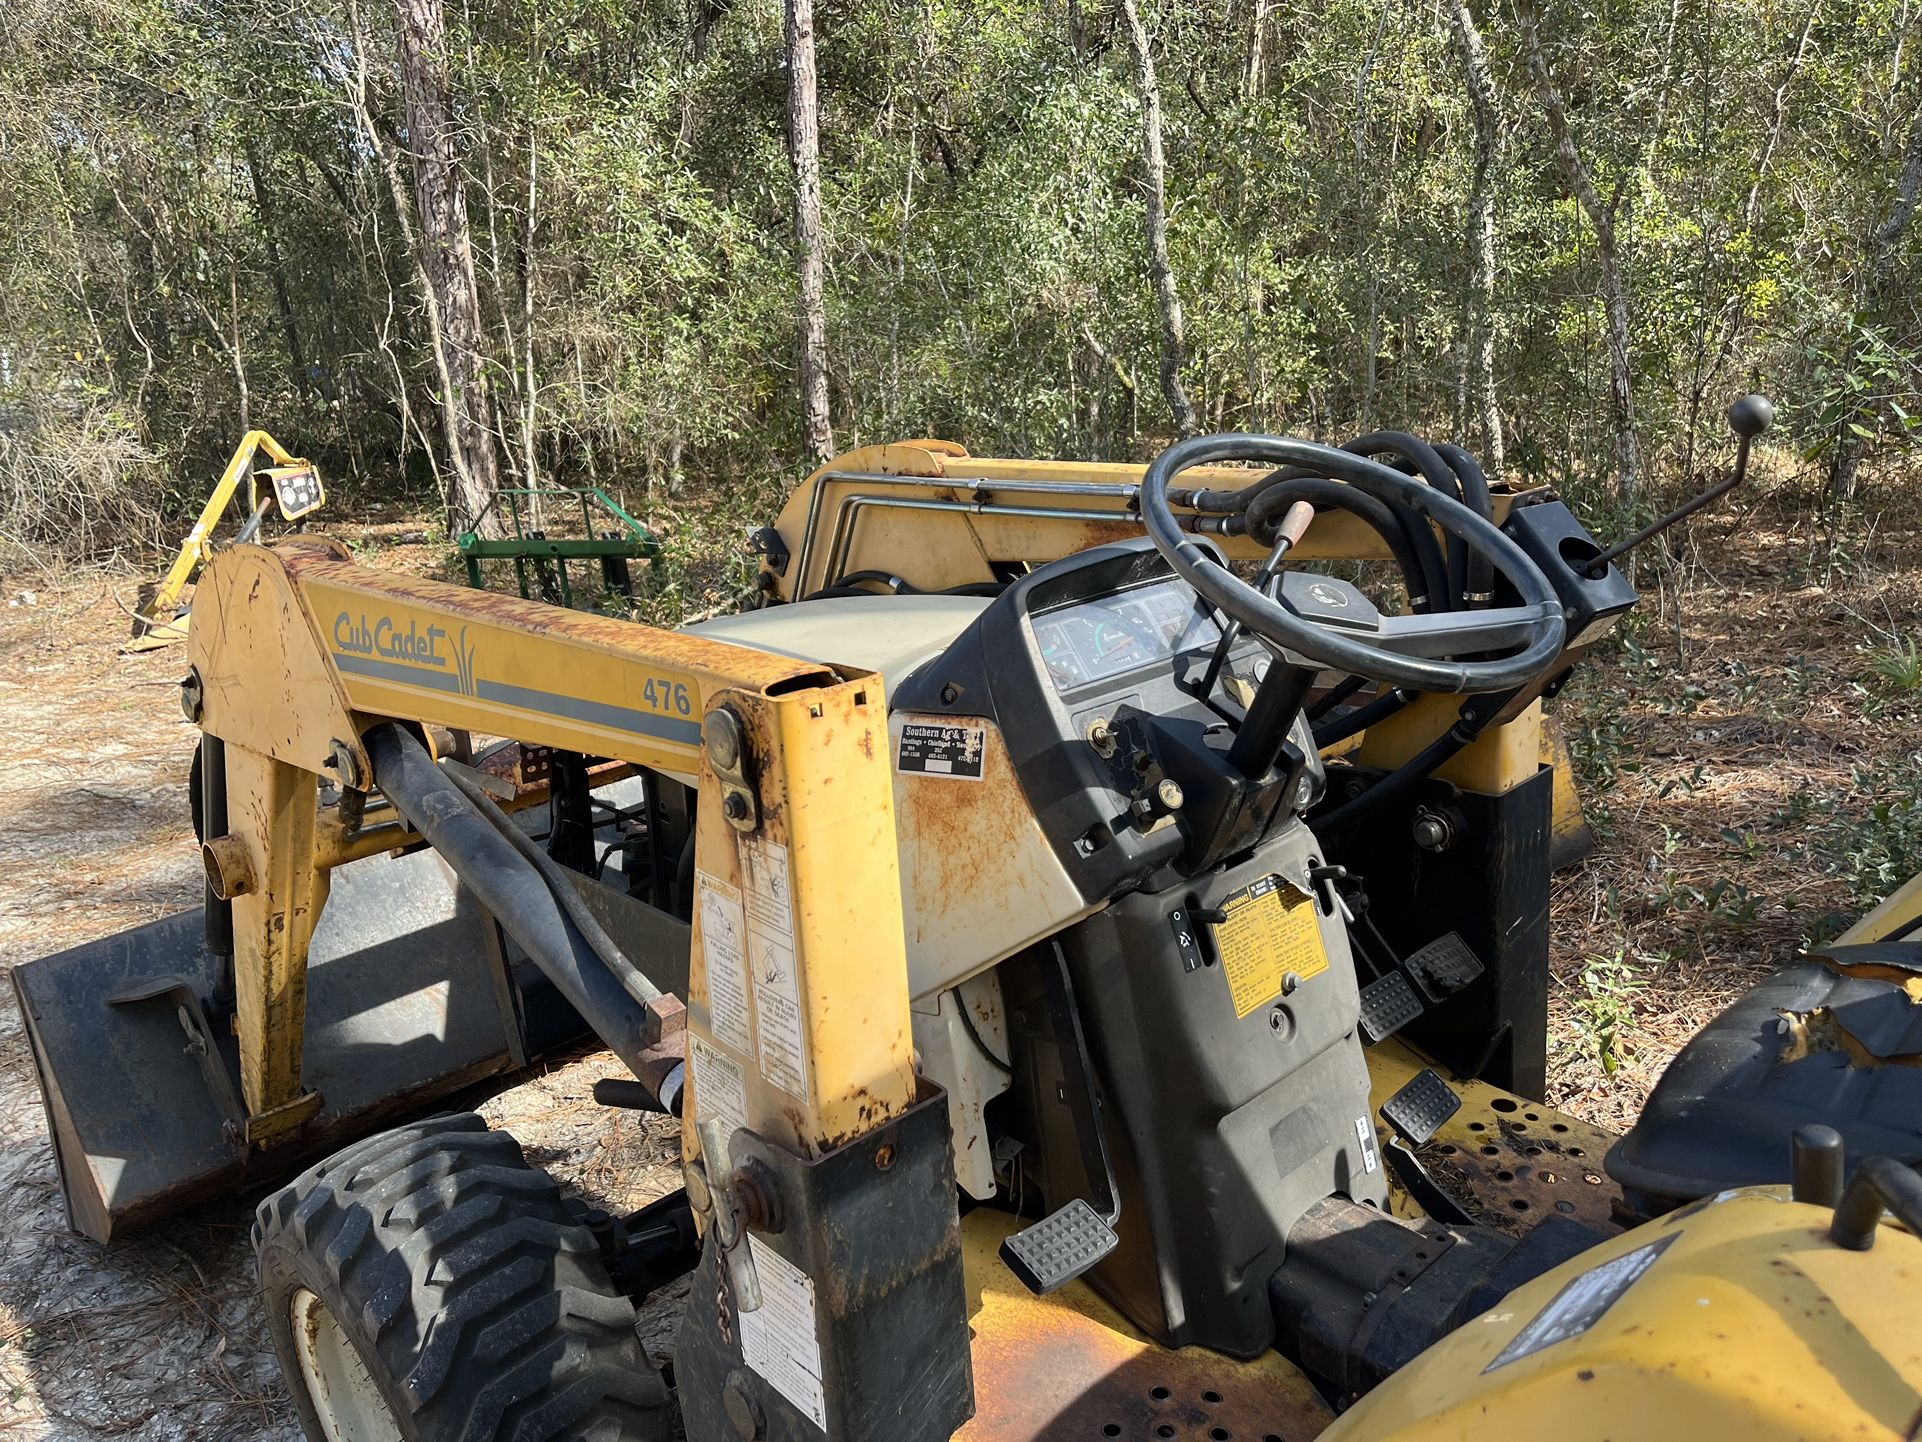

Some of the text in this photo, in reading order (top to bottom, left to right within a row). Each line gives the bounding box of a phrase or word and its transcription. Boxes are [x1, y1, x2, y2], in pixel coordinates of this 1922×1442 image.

[334, 611, 446, 667] Cub Cadet
[643, 677, 691, 715] 476
[906, 726, 939, 738] Southern
